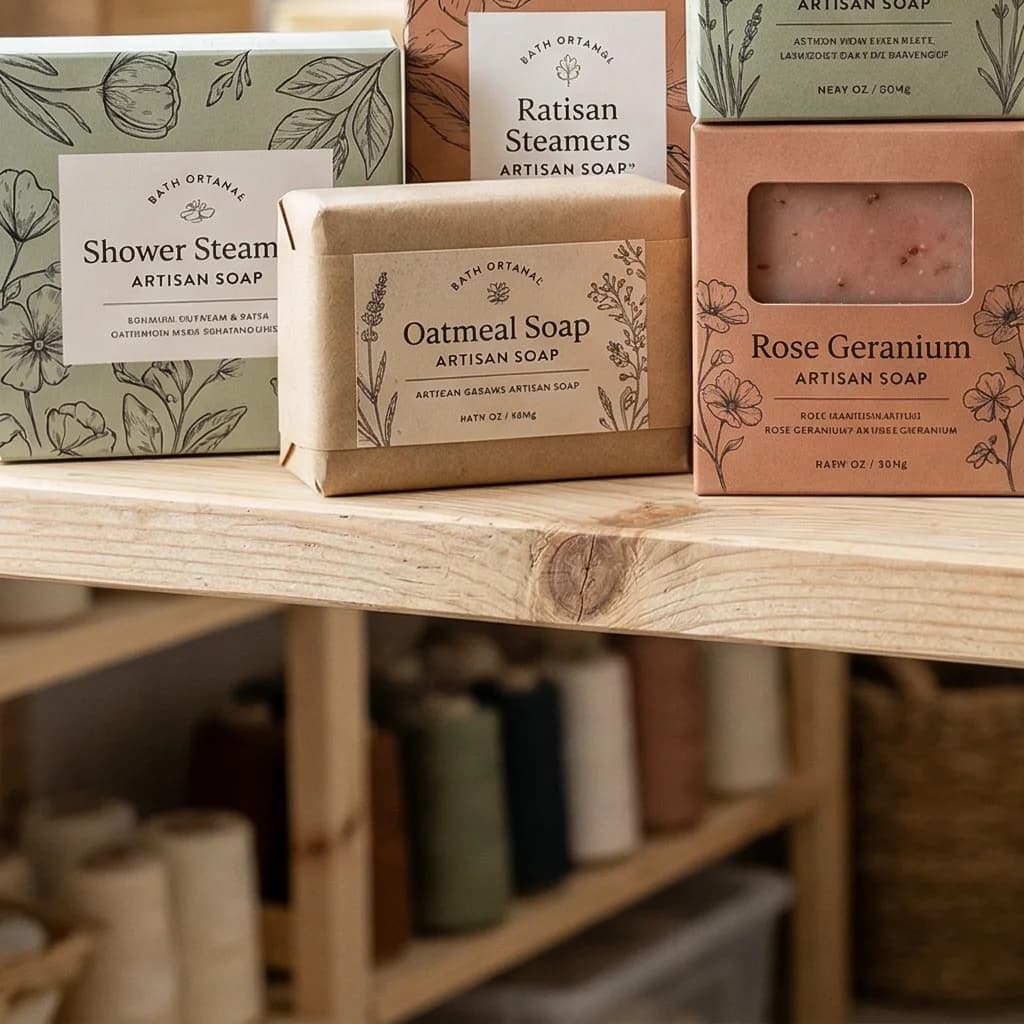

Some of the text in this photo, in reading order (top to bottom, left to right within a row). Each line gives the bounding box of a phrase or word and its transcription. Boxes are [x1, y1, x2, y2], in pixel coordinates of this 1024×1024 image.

[852, 85, 869, 94] OZ
[871, 84, 877, 95] /
[518, 97, 617, 121] Ratisan
[506, 129, 630, 152] Steamers
[500, 164, 574, 176] ARTISAN
[148, 178, 180, 204] BATH
[84, 239, 186, 263] Shower
[132, 272, 262, 287] ARTISAN SOAP
[451, 266, 482, 291] BATH
[404, 315, 590, 345] Oatmeal Soap
[752, 334, 971, 359] Rose Geranium
[436, 349, 558, 367] ARTISAN SOAP
[554, 382, 579, 390] SOAP
[795, 372, 927, 385] ARTISAN SOAP
[489, 413, 502, 421] OZ
[765, 426, 790, 434] ROSE
[851, 460, 865, 469] OZ
